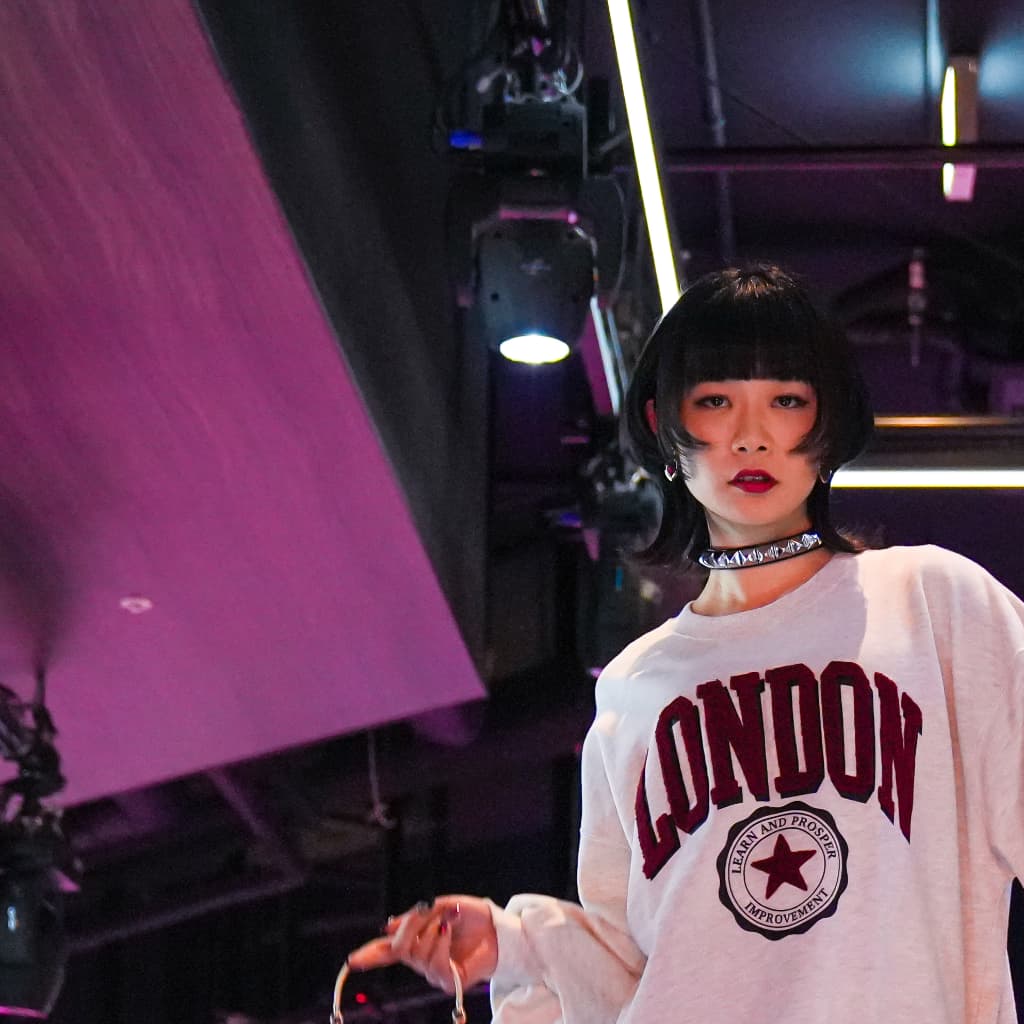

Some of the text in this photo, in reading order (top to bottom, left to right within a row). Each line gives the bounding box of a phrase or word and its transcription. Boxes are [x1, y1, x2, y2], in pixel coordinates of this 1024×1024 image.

[635, 661, 922, 880] LONDON
[732, 816, 837, 874] LEARN AND PROSPER
[744, 887, 829, 924] IMPROVEMENT
